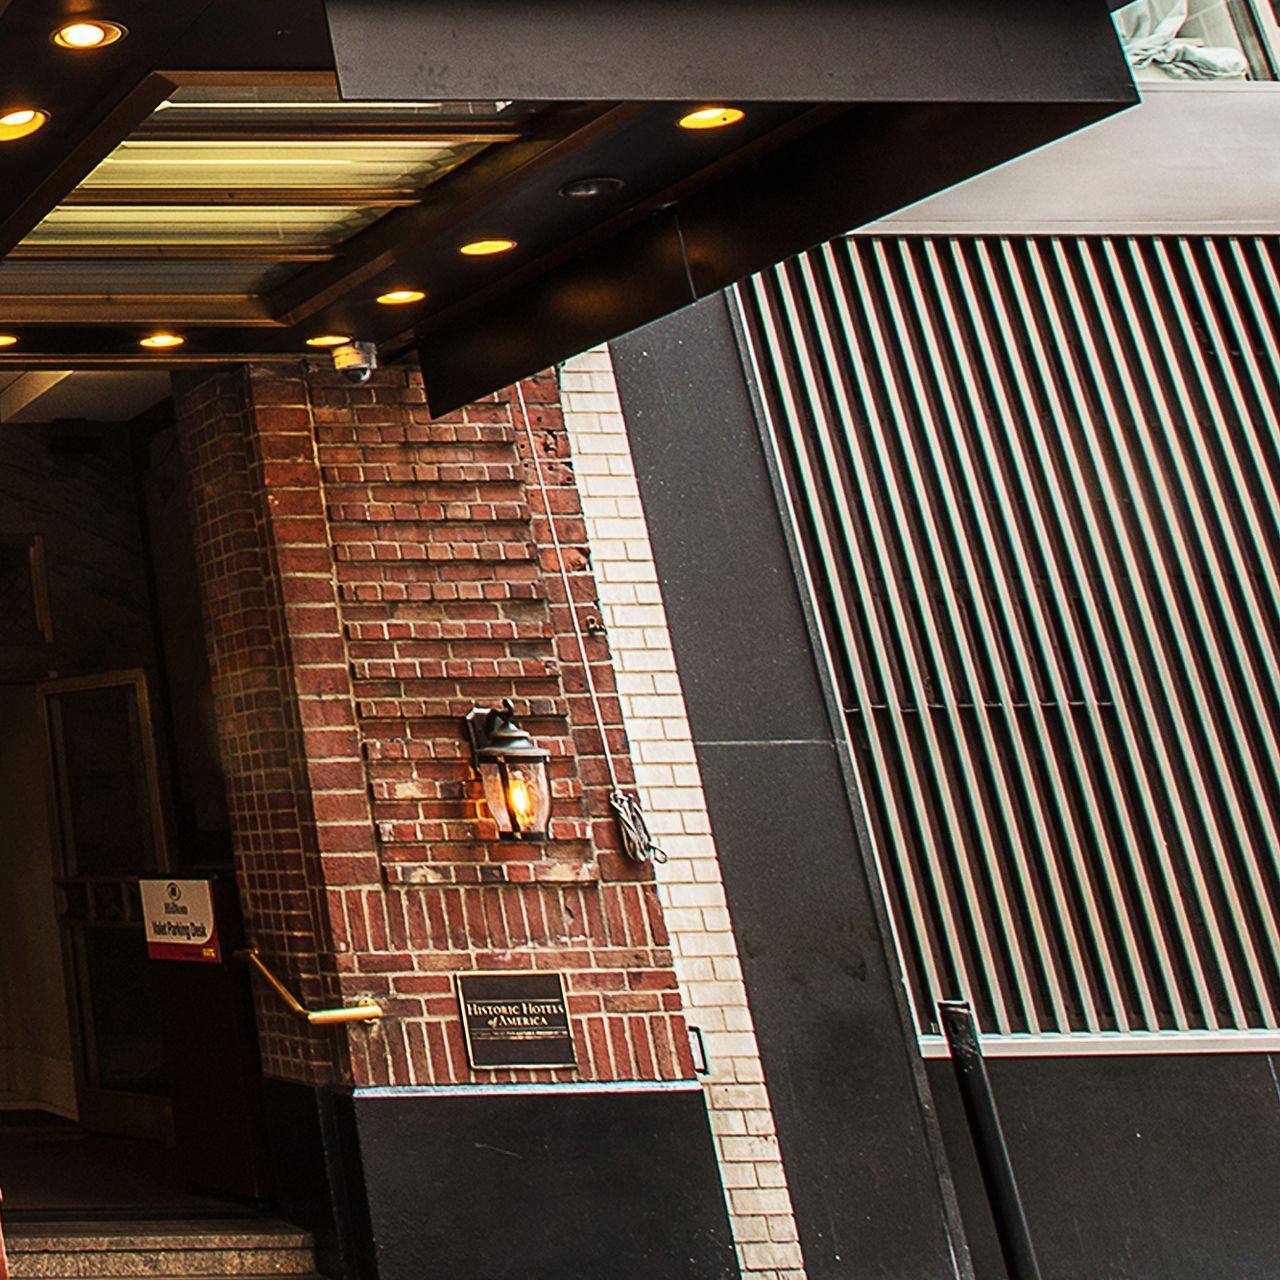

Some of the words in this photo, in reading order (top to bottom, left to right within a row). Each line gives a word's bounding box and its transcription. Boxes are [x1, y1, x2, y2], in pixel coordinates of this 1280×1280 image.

[168, 921, 190, 940] Parking
[467, 1003, 521, 1016] HISTORIC
[522, 1003, 565, 1015] HOTELS
[498, 1015, 548, 1026] AMERICA
